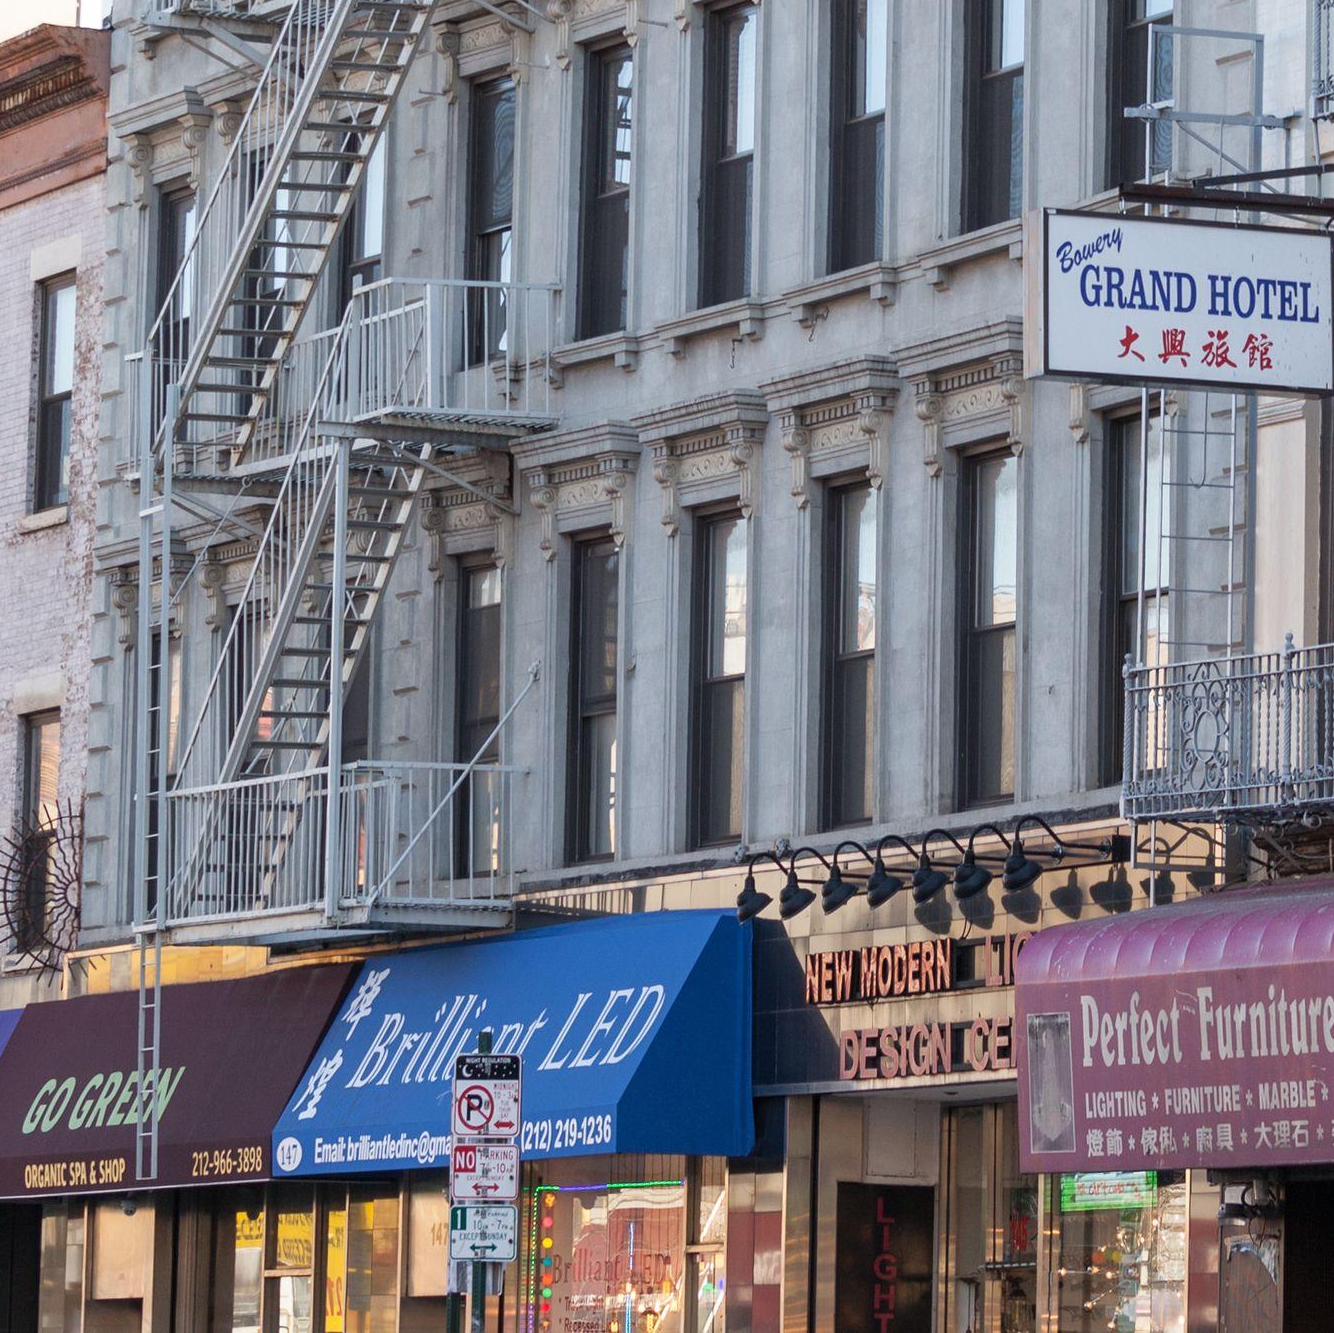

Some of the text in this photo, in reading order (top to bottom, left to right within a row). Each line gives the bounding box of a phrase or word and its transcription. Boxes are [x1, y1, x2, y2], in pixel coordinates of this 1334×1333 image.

[1056, 227, 1124, 274] Bowery
[1079, 264, 1320, 324] GRAND HOTEL
[1117, 325, 1274, 371] 大興旅館
[805, 950, 854, 1004] NEW
[860, 938, 951, 998] MODERN
[538, 984, 666, 1071] LED
[839, 1020, 952, 1080] DESIGN
[1081, 991, 1183, 1067] Perfect
[22, 1066, 186, 1134] GO GREEN
[1085, 1089, 1147, 1119] LIGHTING
[1164, 1084, 1242, 1115] FURNITURE
[1258, 1079, 1317, 1111] MARBLE
[280, 1114, 612, 1166] 147 Email: brilliantledinc@gma (212) 219-1236
[456, 1150, 514, 1170] NO PARKING
[1086, 1128, 1123, 1158] 燈飾
[1254, 1119, 1309, 1150] 大理石
[24, 1162, 67, 1189] ORGANIC
[69, 1161, 87, 1187] SPA
[89, 1163, 97, 1185] &
[99, 1158, 126, 1184] SHOP
[192, 1146, 263, 1178] 212-966-3898
[430, 1222, 449, 1247] 147
[459, 1231, 508, 1241] EXCEP UNDAY
[553, 1246, 622, 1285] Brilliant
[872, 1196, 898, 1333] LIGHT
